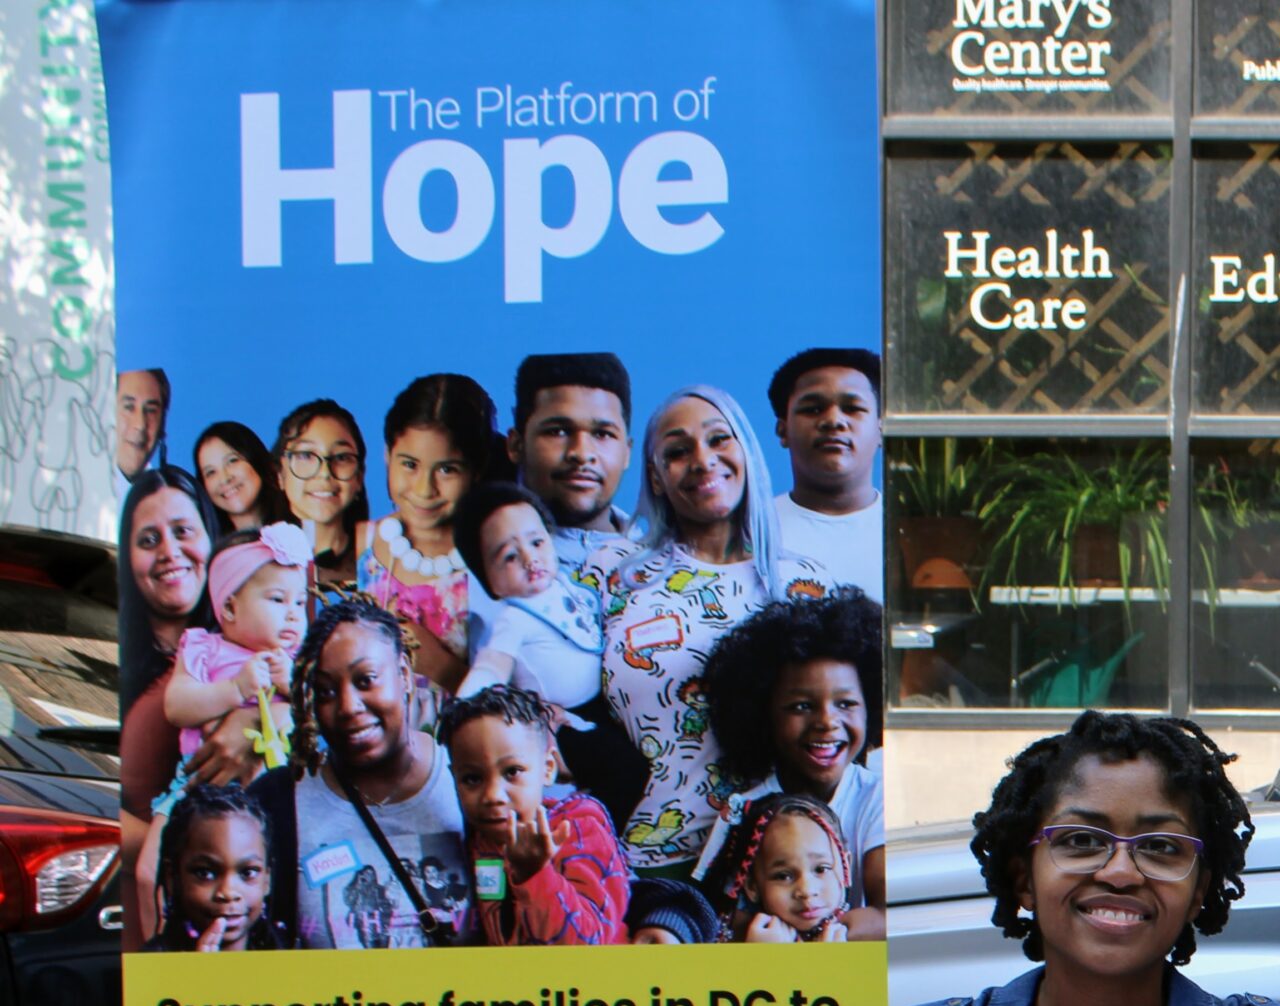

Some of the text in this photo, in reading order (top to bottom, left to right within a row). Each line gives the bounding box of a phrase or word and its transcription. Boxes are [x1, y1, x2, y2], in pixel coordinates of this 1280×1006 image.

[953, 0, 1112, 37] Mary's
[951, 32, 1112, 75] Center
[378, 76, 718, 132] The Platform of
[240, 89, 729, 304] Hope
[943, 229, 1112, 279] Health
[969, 283, 1087, 331] Care
